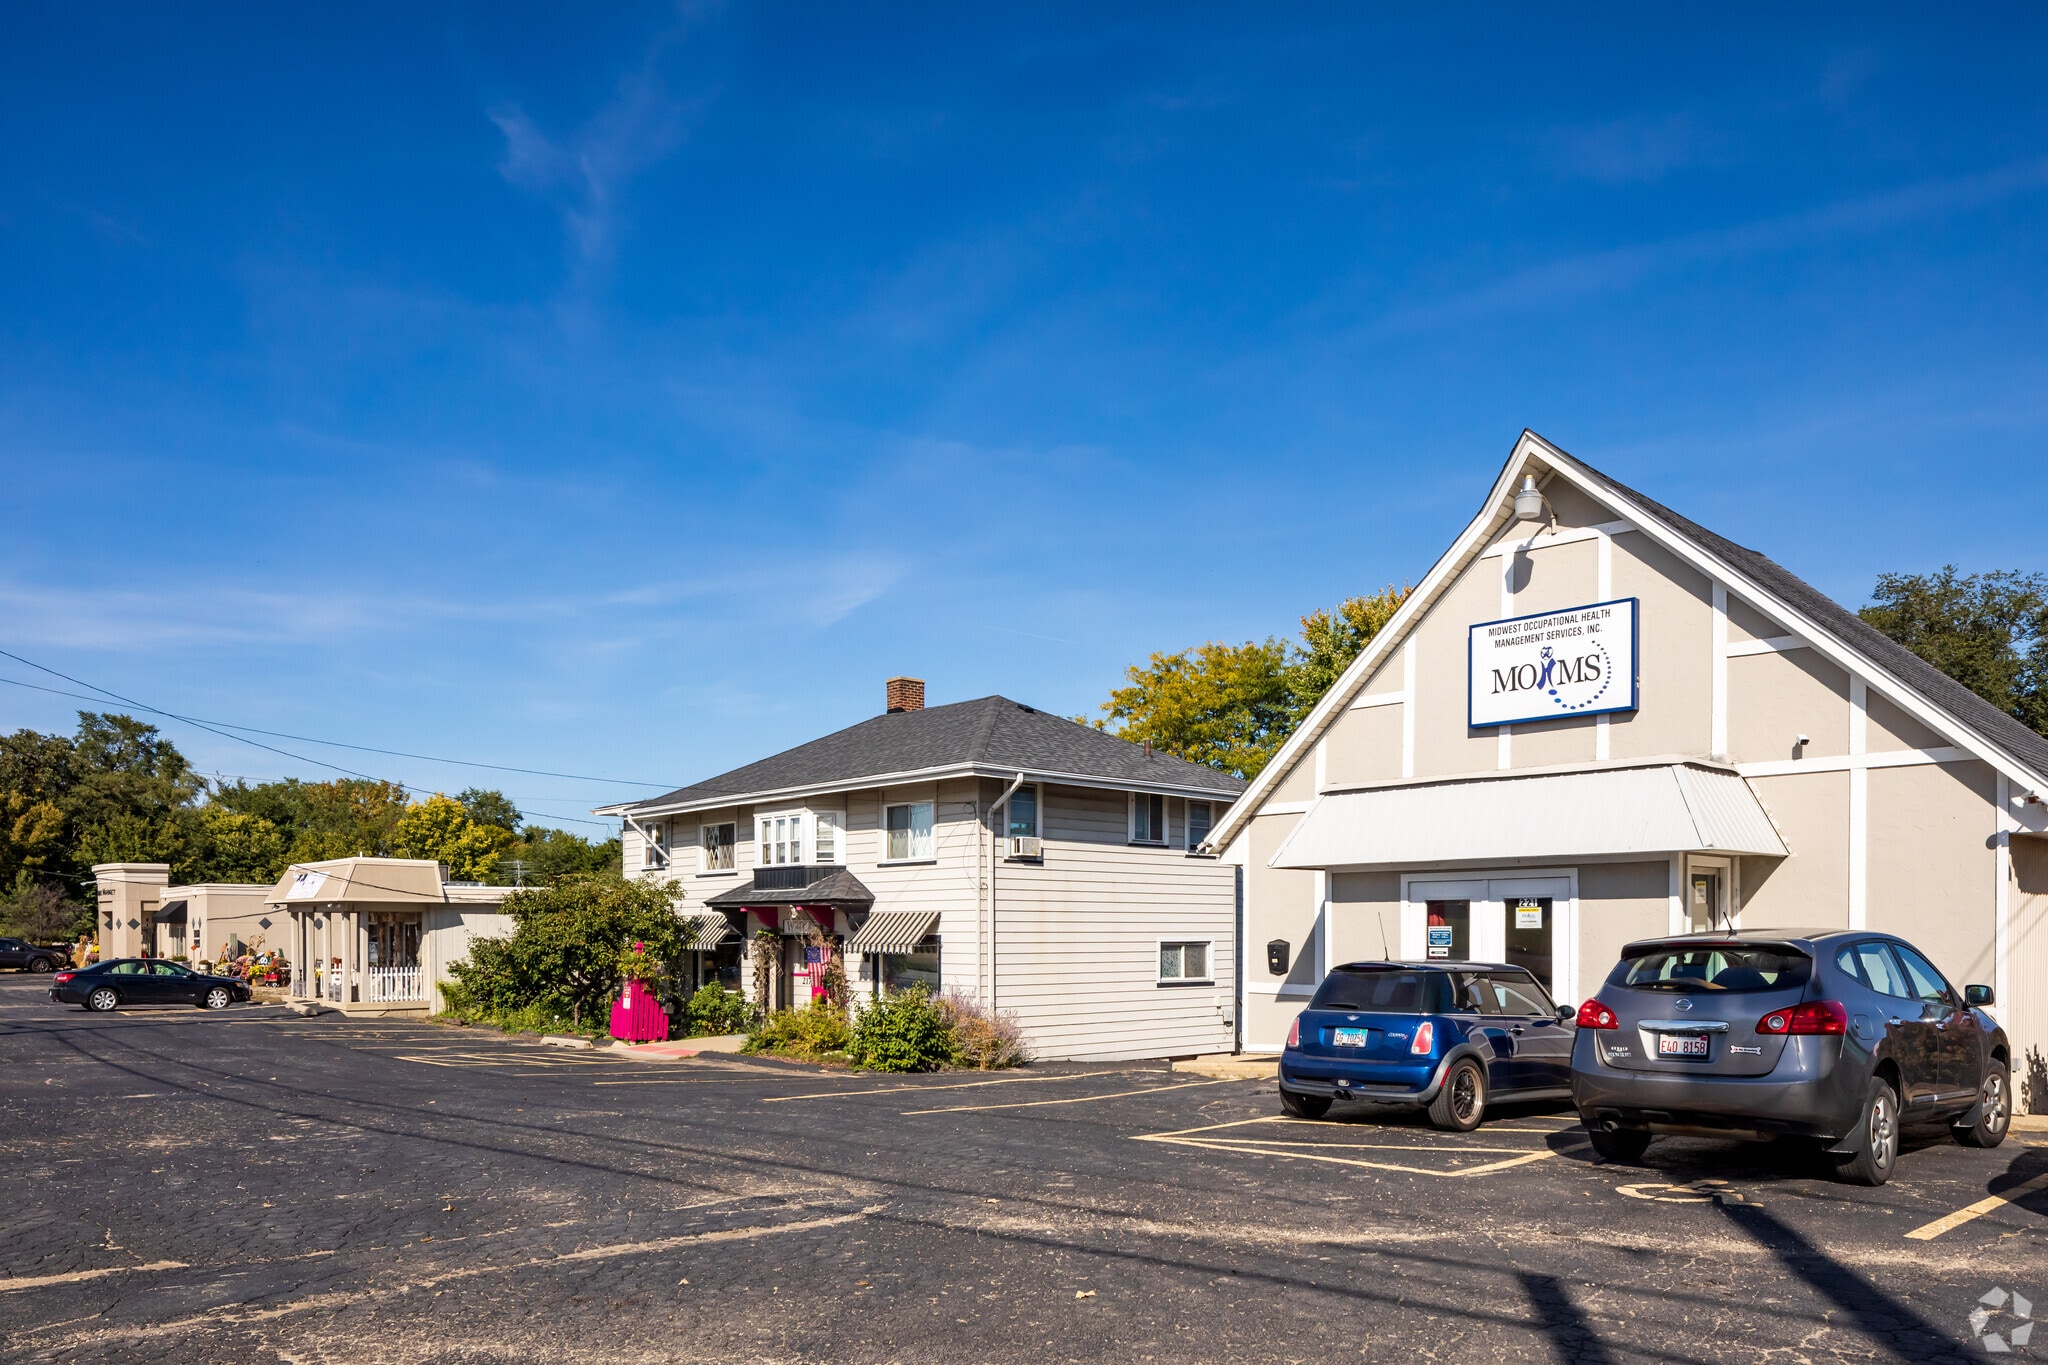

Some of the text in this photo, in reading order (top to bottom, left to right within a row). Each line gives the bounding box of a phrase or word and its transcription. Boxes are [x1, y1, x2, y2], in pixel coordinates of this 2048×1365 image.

[1488, 608, 1611, 637] MIDWEST OCCUPATIONAL HEALTH
[1494, 623, 1603, 649] MANAGEMENT SERVICES, INC.
[1520, 898, 1536, 907] 221
[1661, 1040, 1706, 1054] E40 8158
